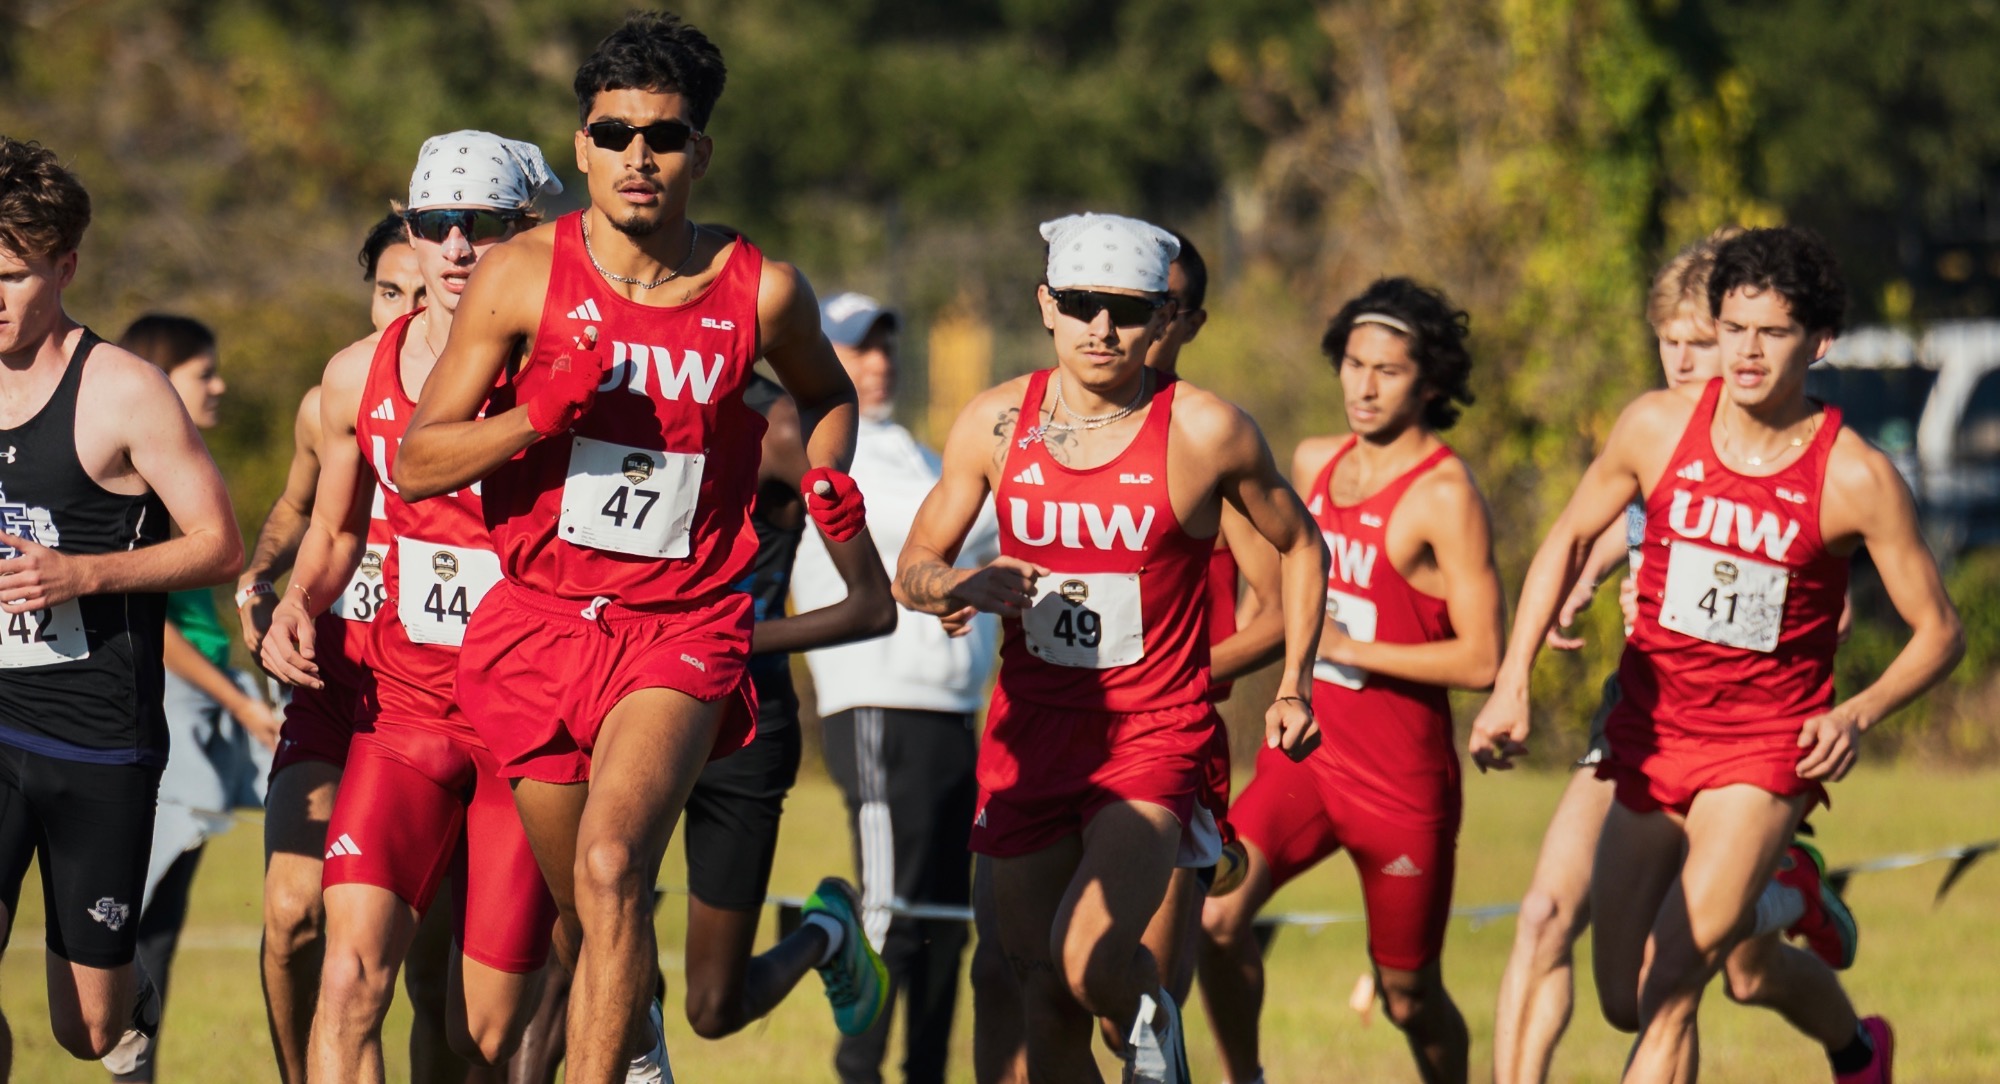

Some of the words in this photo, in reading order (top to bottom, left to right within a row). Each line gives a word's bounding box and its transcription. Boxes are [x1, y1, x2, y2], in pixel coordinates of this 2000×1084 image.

[601, 486, 660, 530] 47
[1009, 497, 1155, 551] UIW
[1669, 489, 1800, 561] UIW
[424, 583, 471, 624] 44
[1698, 588, 1738, 624] 41
[0, 608, 58, 645] 42
[1053, 609, 1101, 648] 49
